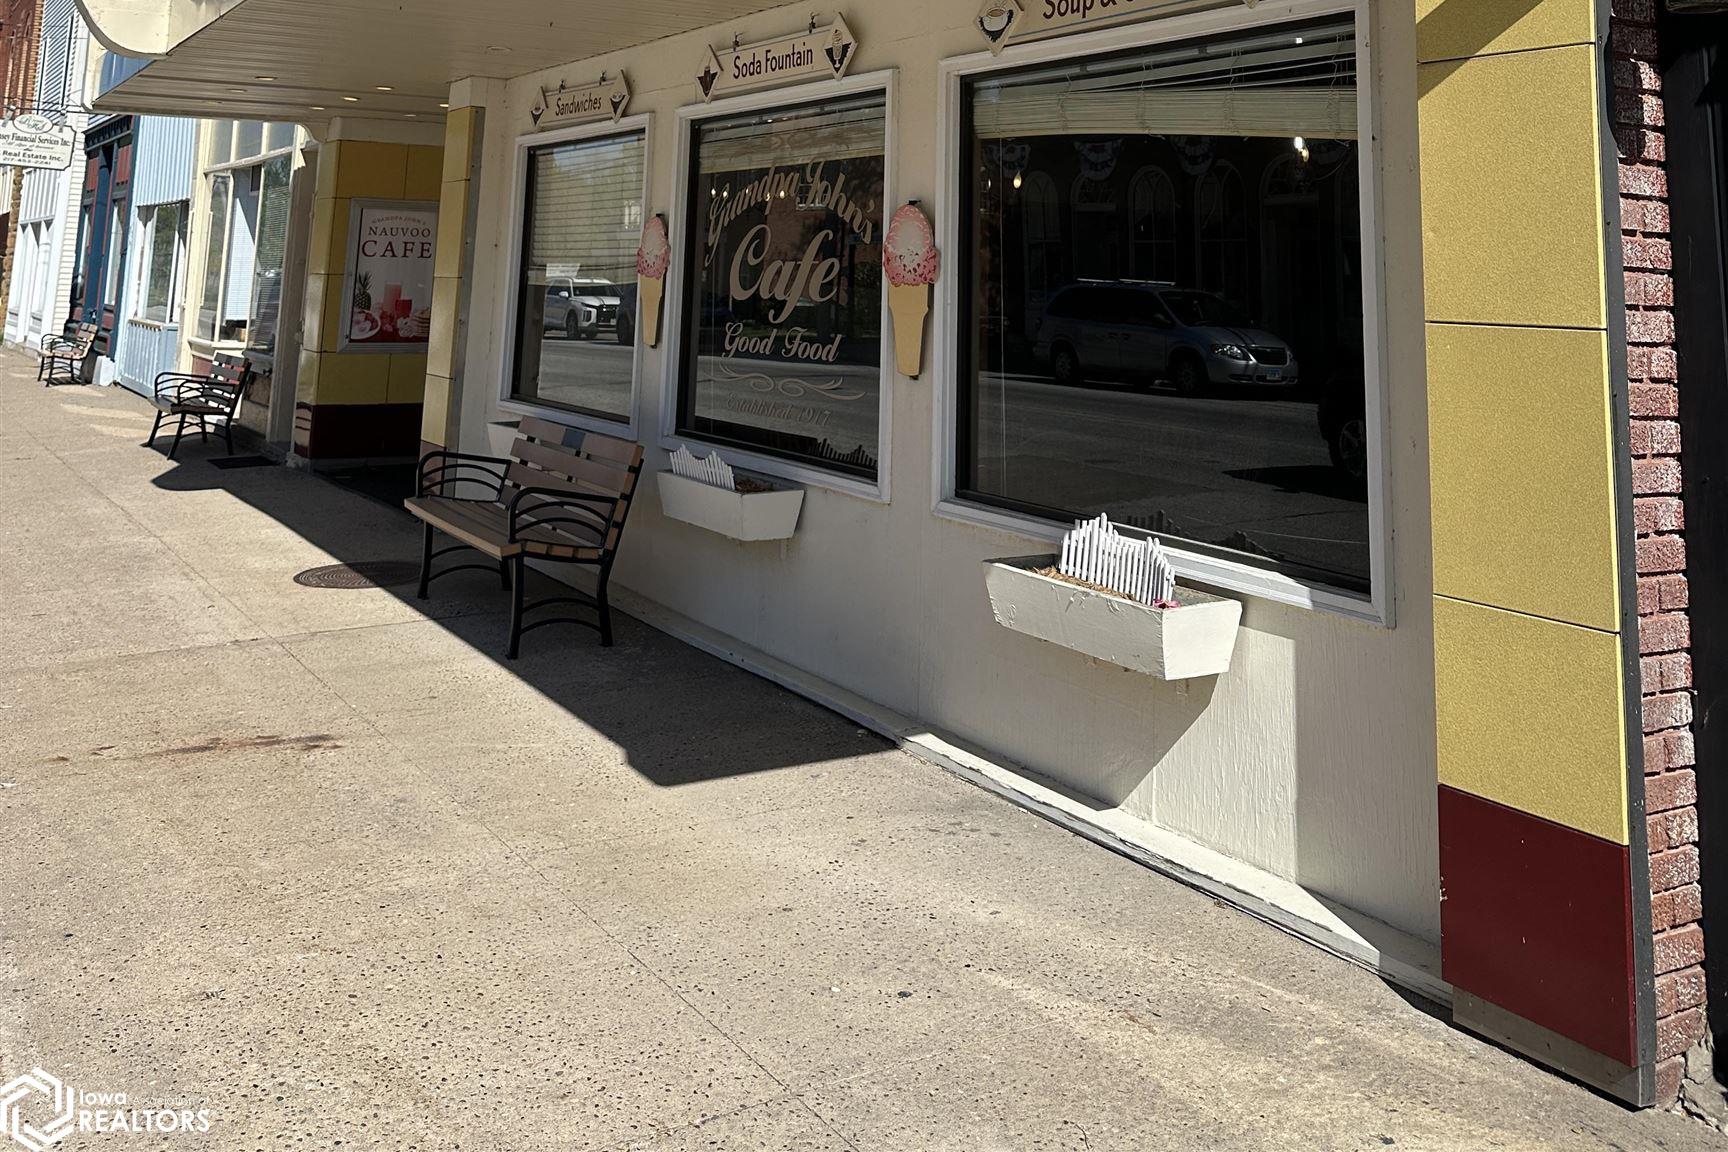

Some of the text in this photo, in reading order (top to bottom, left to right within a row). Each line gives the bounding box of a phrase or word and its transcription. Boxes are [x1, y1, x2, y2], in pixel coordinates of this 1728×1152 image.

[733, 42, 813, 79] Soda Fountain
[555, 93, 602, 116] Sandwiches
[12, 133, 37, 143] Financial
[38, 136, 59, 145] Services
[3, 150, 21, 158] Real
[23, 152, 47, 160] Estate
[705, 157, 876, 267] Grandpa John's
[368, 226, 430, 237] NAUVOO
[361, 240, 432, 258] CAFE
[729, 224, 840, 324] Cafe
[721, 322, 841, 362] Good Food
